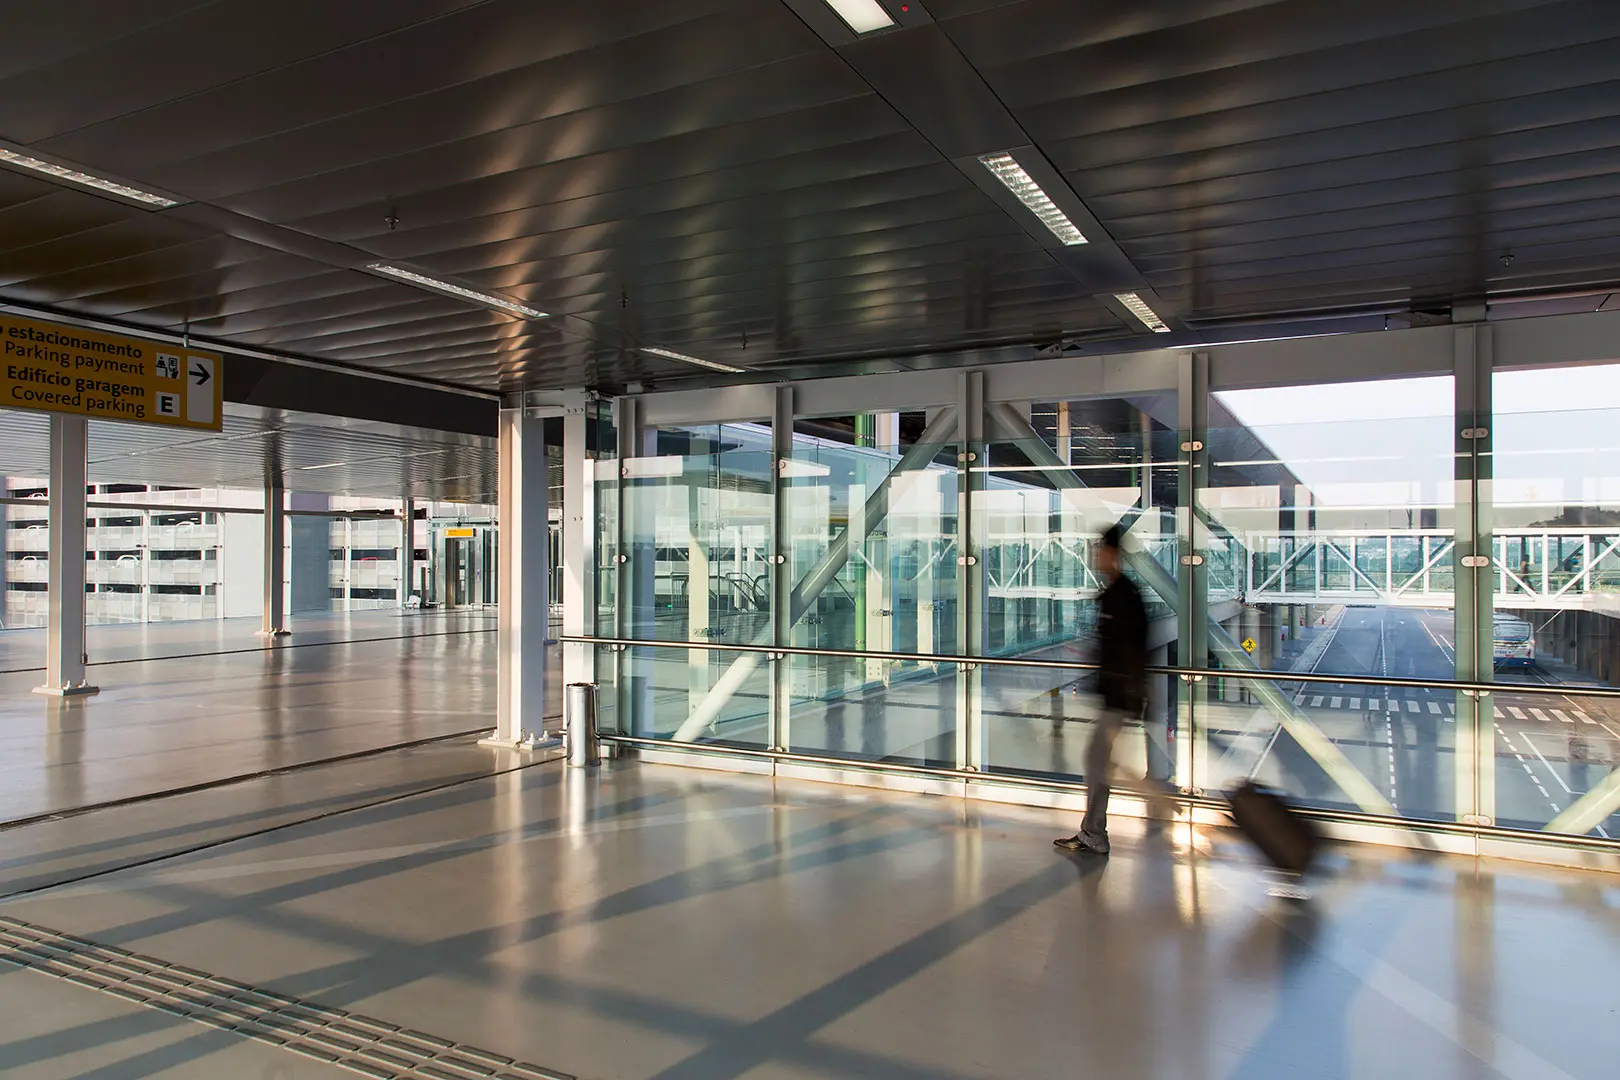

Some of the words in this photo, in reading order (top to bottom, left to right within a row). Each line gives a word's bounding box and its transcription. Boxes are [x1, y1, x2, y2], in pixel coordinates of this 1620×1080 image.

[5, 341, 71, 368] Parking
[75, 355, 145, 376] payment
[8, 326, 143, 359] estacionamento
[11, 385, 81, 407] Covered
[86, 398, 145, 419] parking
[75, 378, 145, 398] garagem
[161, 395, 173, 413] E
